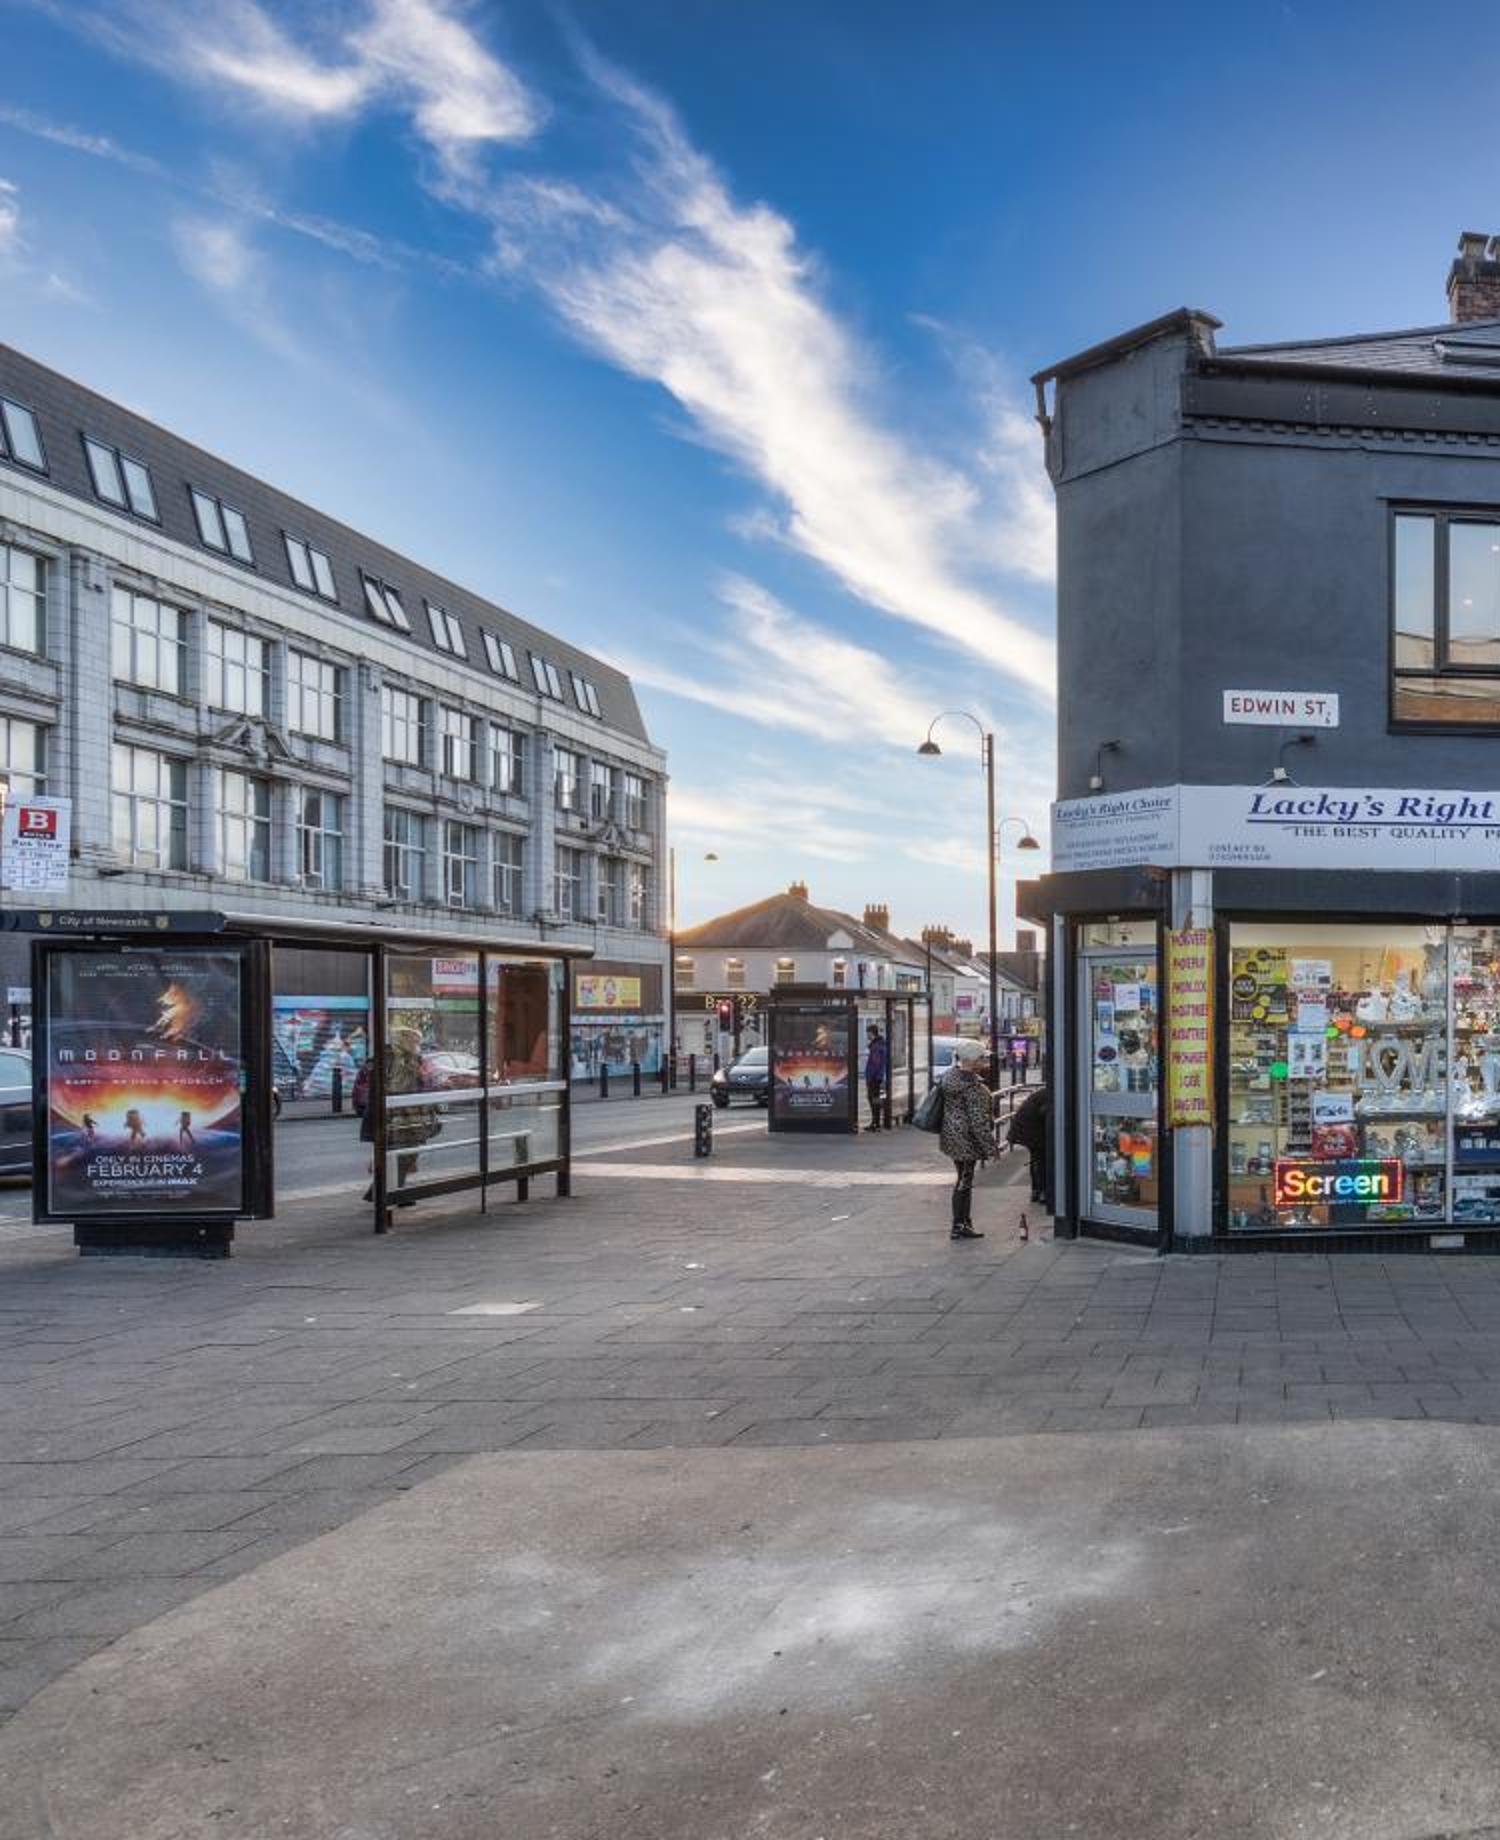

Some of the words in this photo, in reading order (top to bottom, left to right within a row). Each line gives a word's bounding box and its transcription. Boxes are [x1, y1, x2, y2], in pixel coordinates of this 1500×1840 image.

[1231, 698, 1295, 714] EDWIN
[1248, 793, 1385, 821] Lacky's
[1396, 796, 1493, 823] Right
[28, 811, 49, 829] B
[1333, 827, 1381, 839] BEST
[1389, 827, 1471, 840] QUALITY
[59, 912, 80, 927] City
[59, 1049, 231, 1061] MOONFALL
[96, 1156, 125, 1164] ONLY
[143, 1154, 195, 1163] CINEMAS
[87, 1164, 187, 1177] FEBRUARY
[193, 1163, 203, 1175] 4
[1284, 1170, 1389, 1196] Screen
